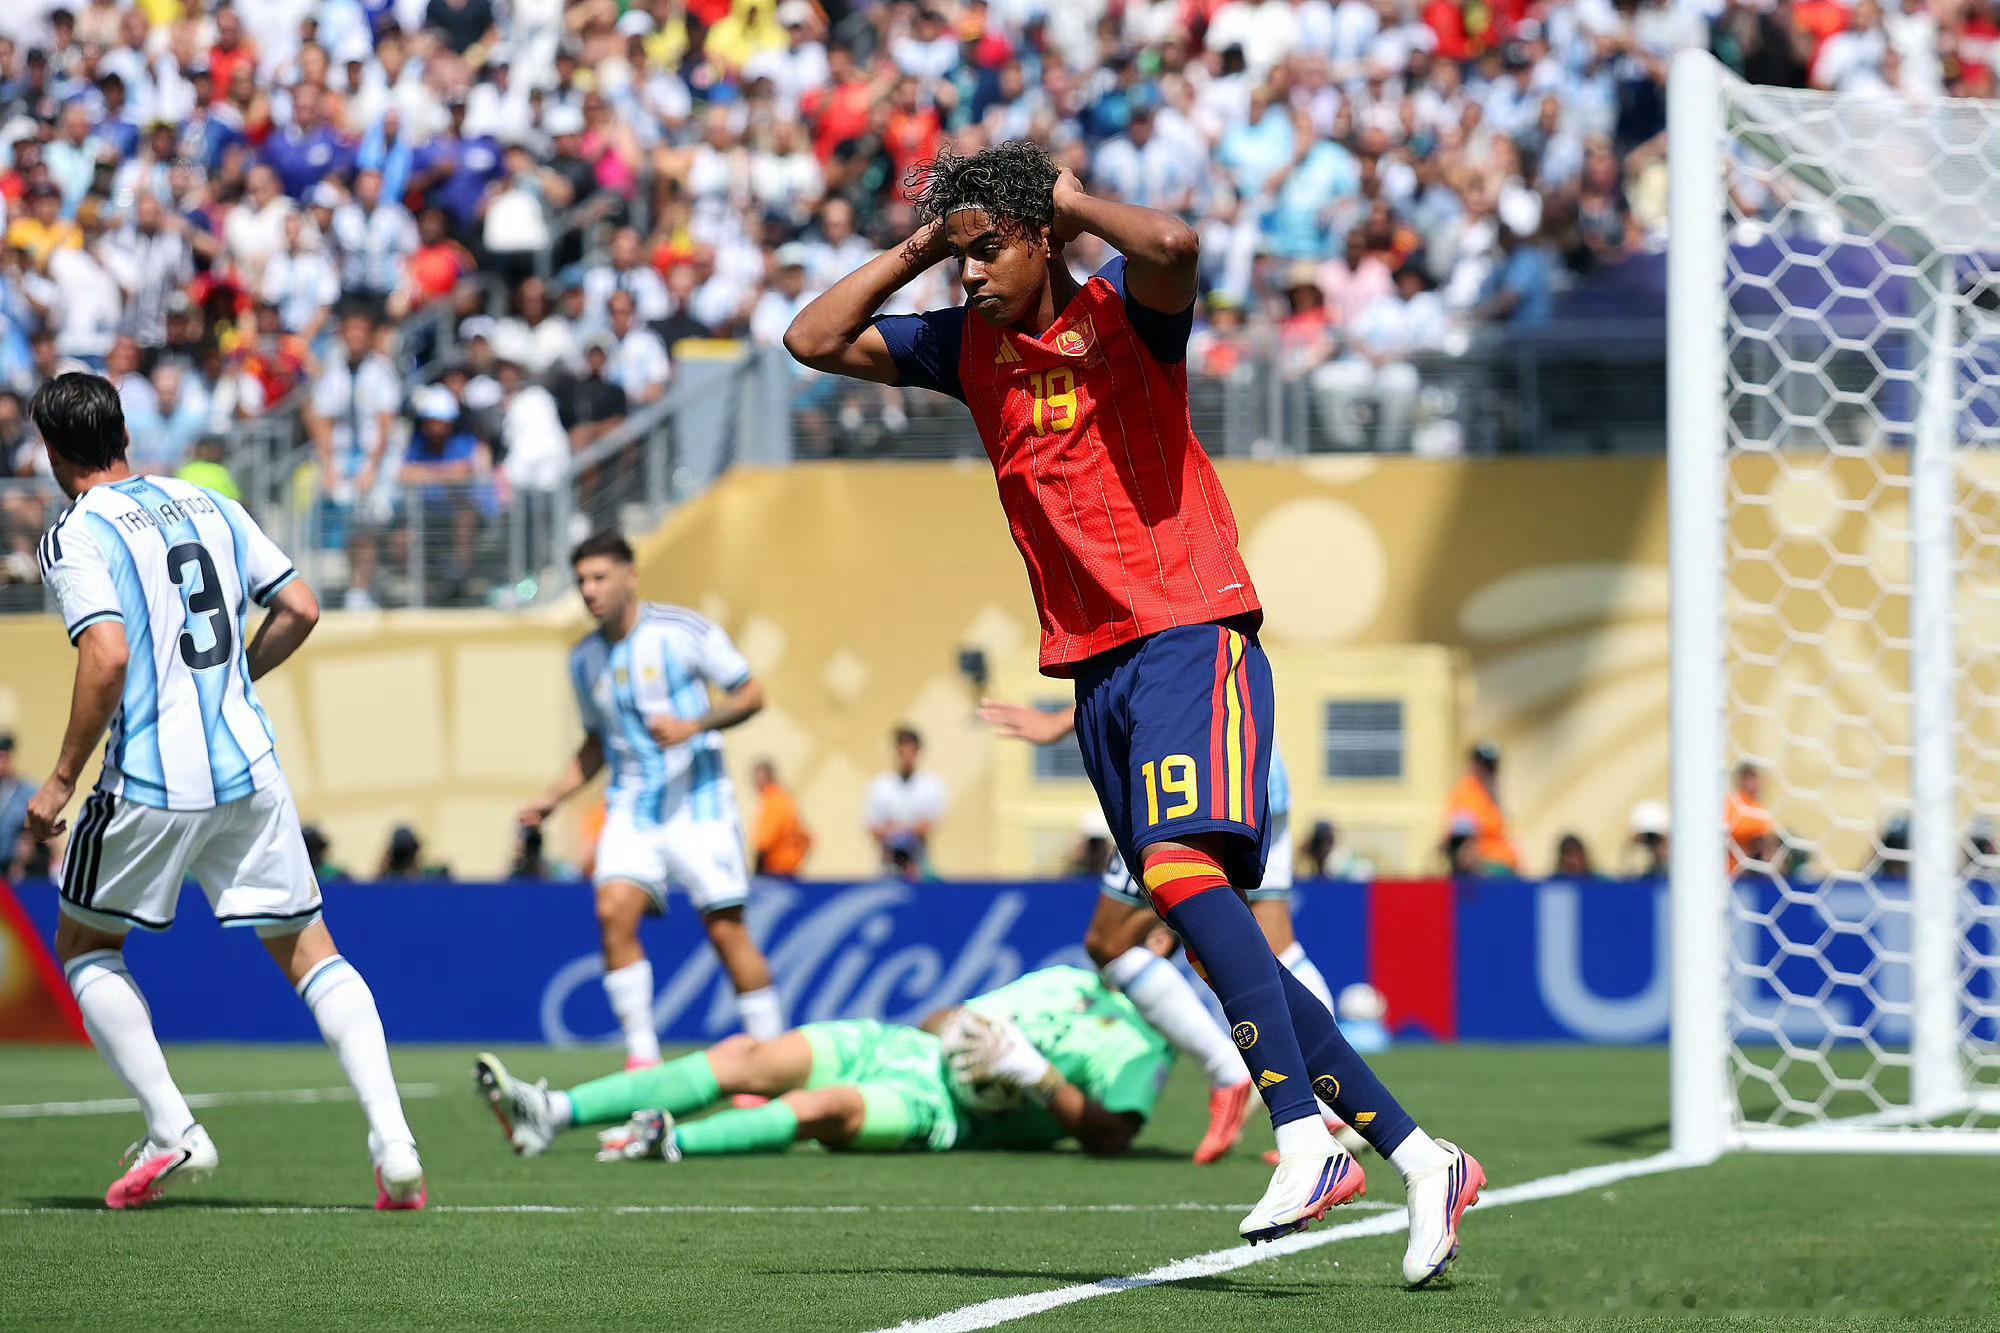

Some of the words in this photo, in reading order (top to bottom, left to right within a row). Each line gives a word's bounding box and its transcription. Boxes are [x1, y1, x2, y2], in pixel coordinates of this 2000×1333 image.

[1030, 367, 1077, 437] 19
[167, 543, 232, 670] 3
[1142, 754, 1199, 827] 19
